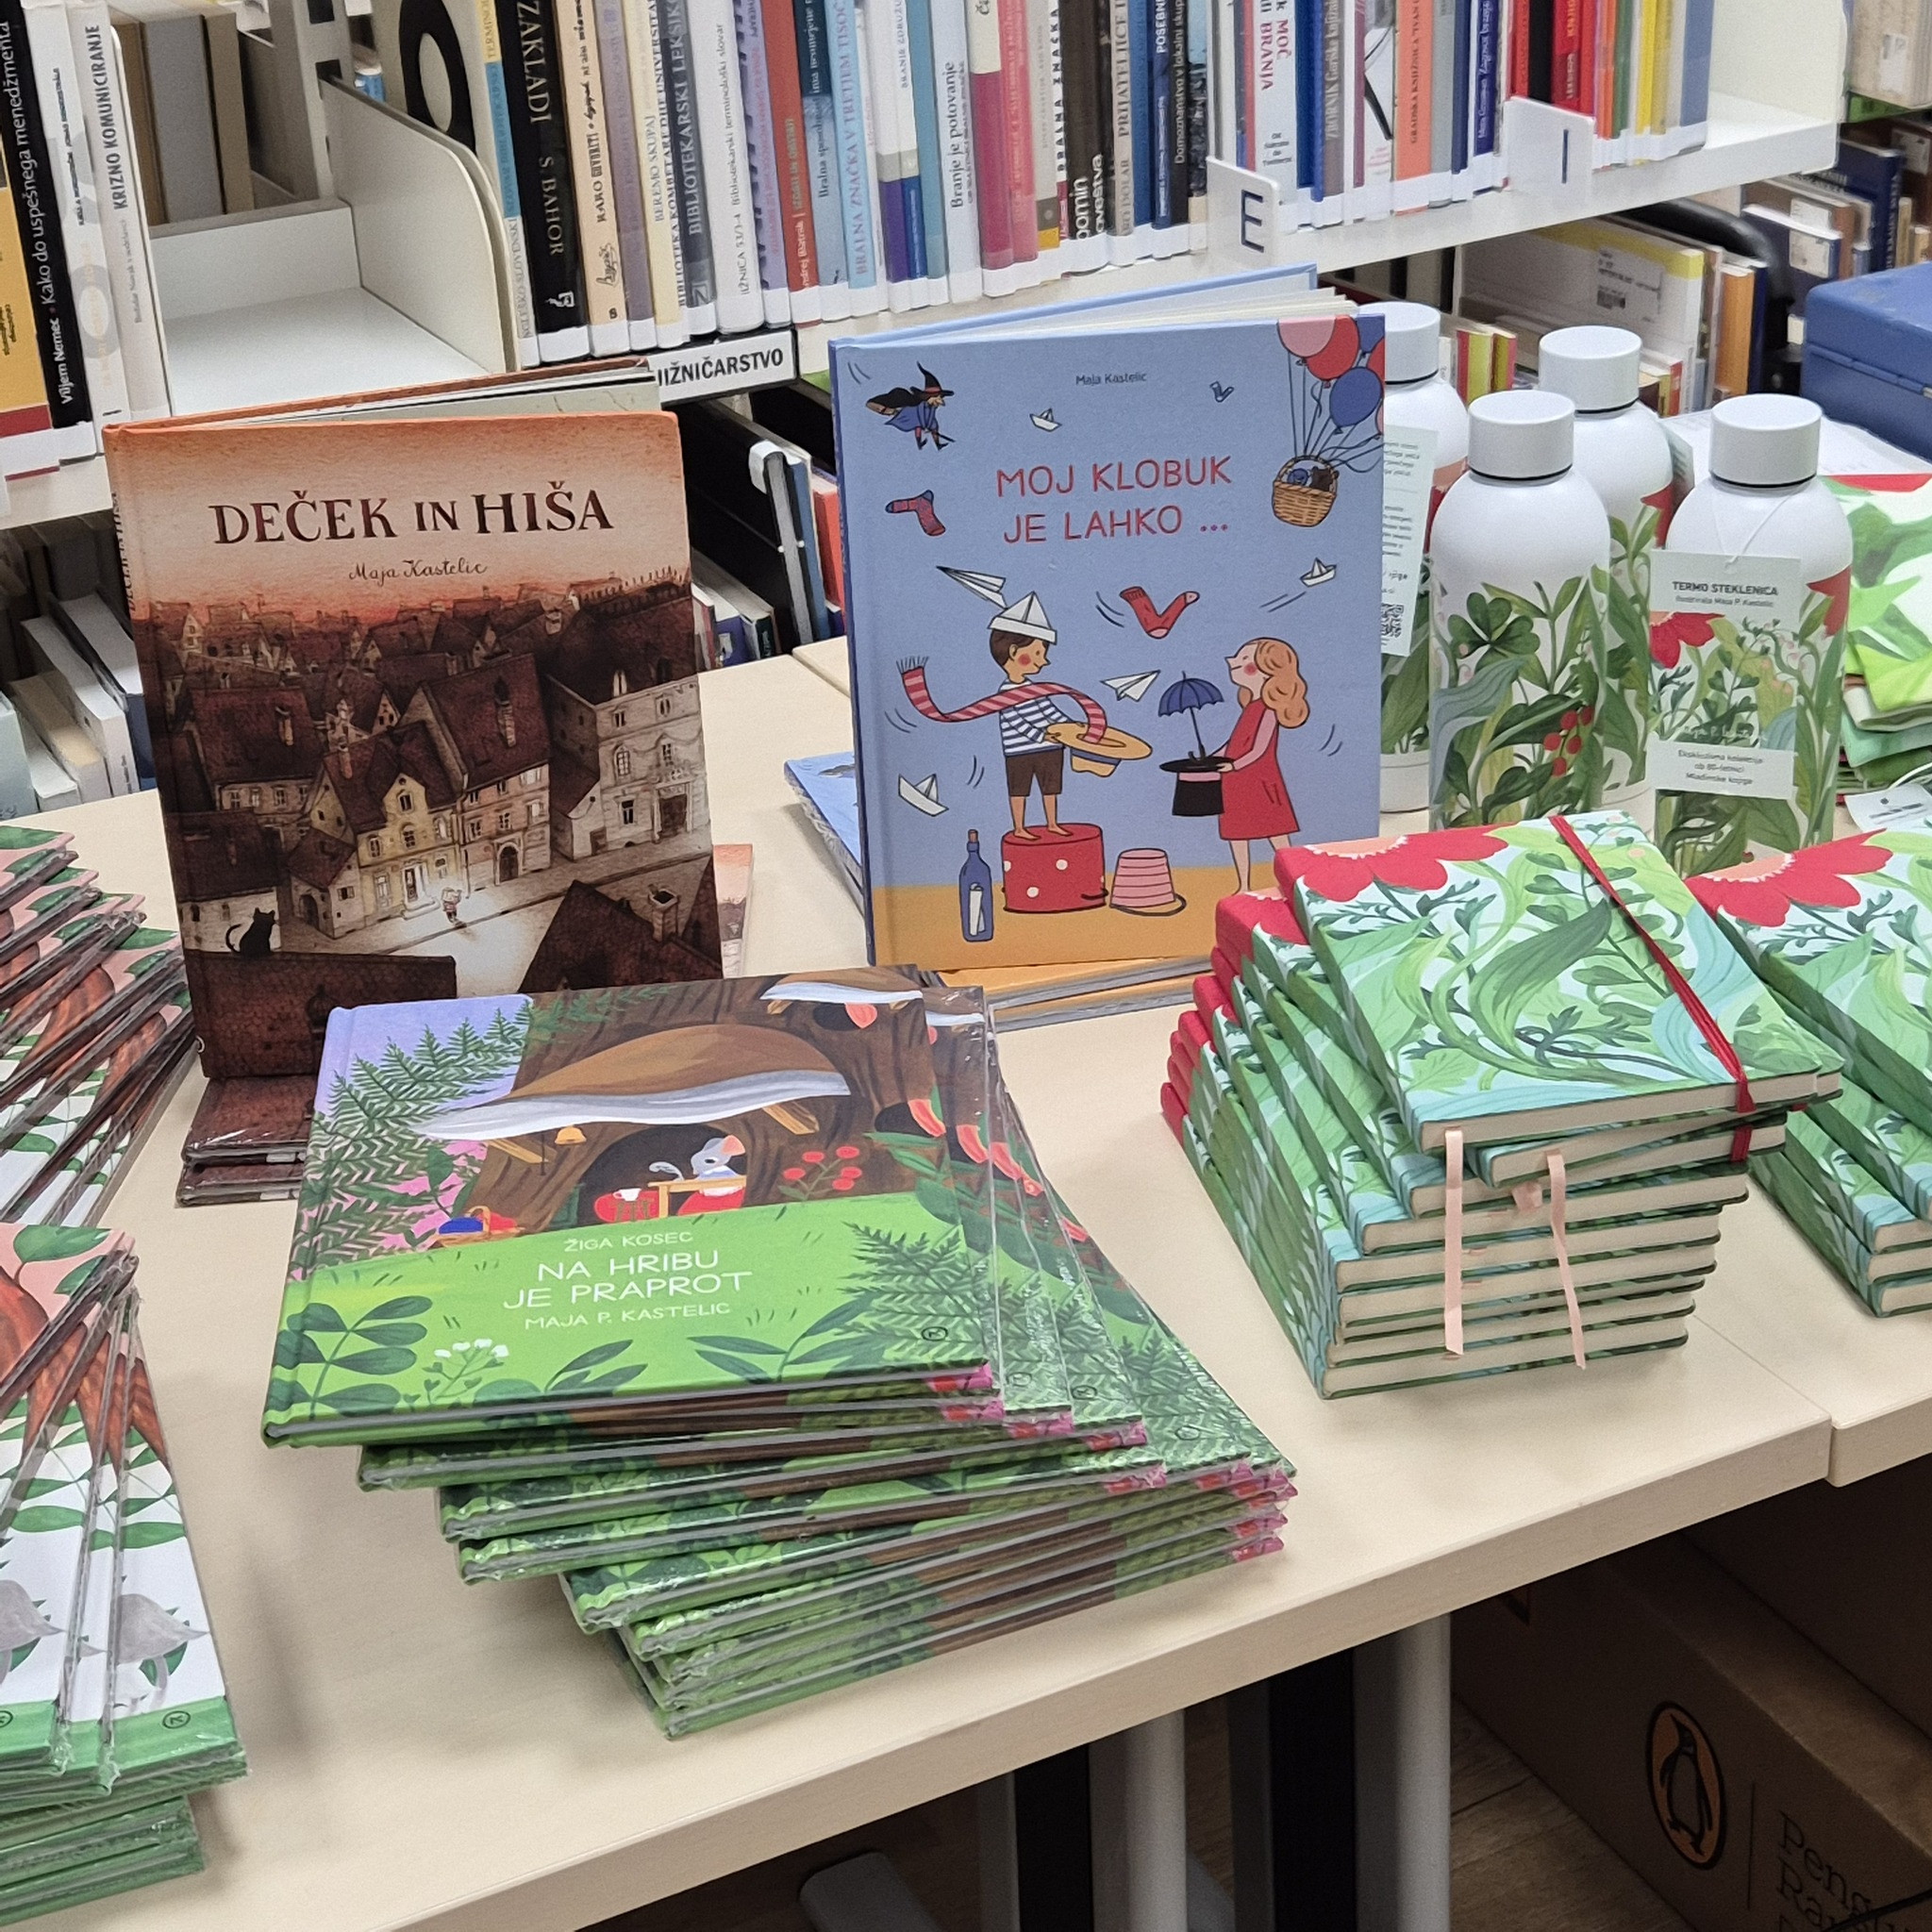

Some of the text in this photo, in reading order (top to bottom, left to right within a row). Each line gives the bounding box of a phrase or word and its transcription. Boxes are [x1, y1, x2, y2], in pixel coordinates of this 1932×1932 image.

[714, 24, 726, 58] slovar
[1173, 29, 1184, 68] lokalni
[1259, 23, 1274, 91] BRANJA
[1275, 19, 1292, 60] MOČ
[718, 60, 734, 129] terminološki
[837, 55, 855, 126] TRETJEM
[1115, 15, 1129, 138] PRIJATELJICE
[85, 25, 129, 210] KRIZNO KOMUNICIRANJE
[518, 0, 551, 124] ZAKLADI
[542, 177, 564, 256] BAHOR
[845, 128, 858, 140] V
[941, 61, 965, 208] Branje je potovanje
[1053, 98, 1065, 174] BRALNA
[1174, 78, 1185, 164] Domoznanstvo
[643, 114, 664, 223] BEREMO SKUPAJ
[675, 79, 704, 236] BIBLIOTEKARSKI
[725, 131, 741, 207] Bibliotekarski
[817, 160, 829, 198] Bralna
[845, 143, 863, 208] ZNAČKA
[1120, 159, 1130, 208] DOLAR
[0, 21, 75, 405] Viljem Nemec Kako do uspešnega menedžmenta
[852, 212, 869, 275] BRALNA
[1241, 189, 1265, 254] E
[799, 258, 810, 288] ndrej
[1075, 371, 1148, 387] Maja Kastelic
[995, 455, 1233, 497] MOJ KLOBUK
[208, 481, 615, 545] DEČEK IN HIŠA
[1003, 513, 1047, 544] JE
[1063, 505, 1183, 541] LAHKO
[349, 558, 489, 588] Maja Kastelic
[1672, 580, 1779, 596] TERMO STEKLENICA
[537, 1250, 719, 1283] NA HRIBU
[564, 1229, 693, 1252] ŽIGA KOSEC
[503, 1271, 753, 1310] JE PRAPROT
[524, 1302, 731, 1331] MAJA P. KASTELIC
